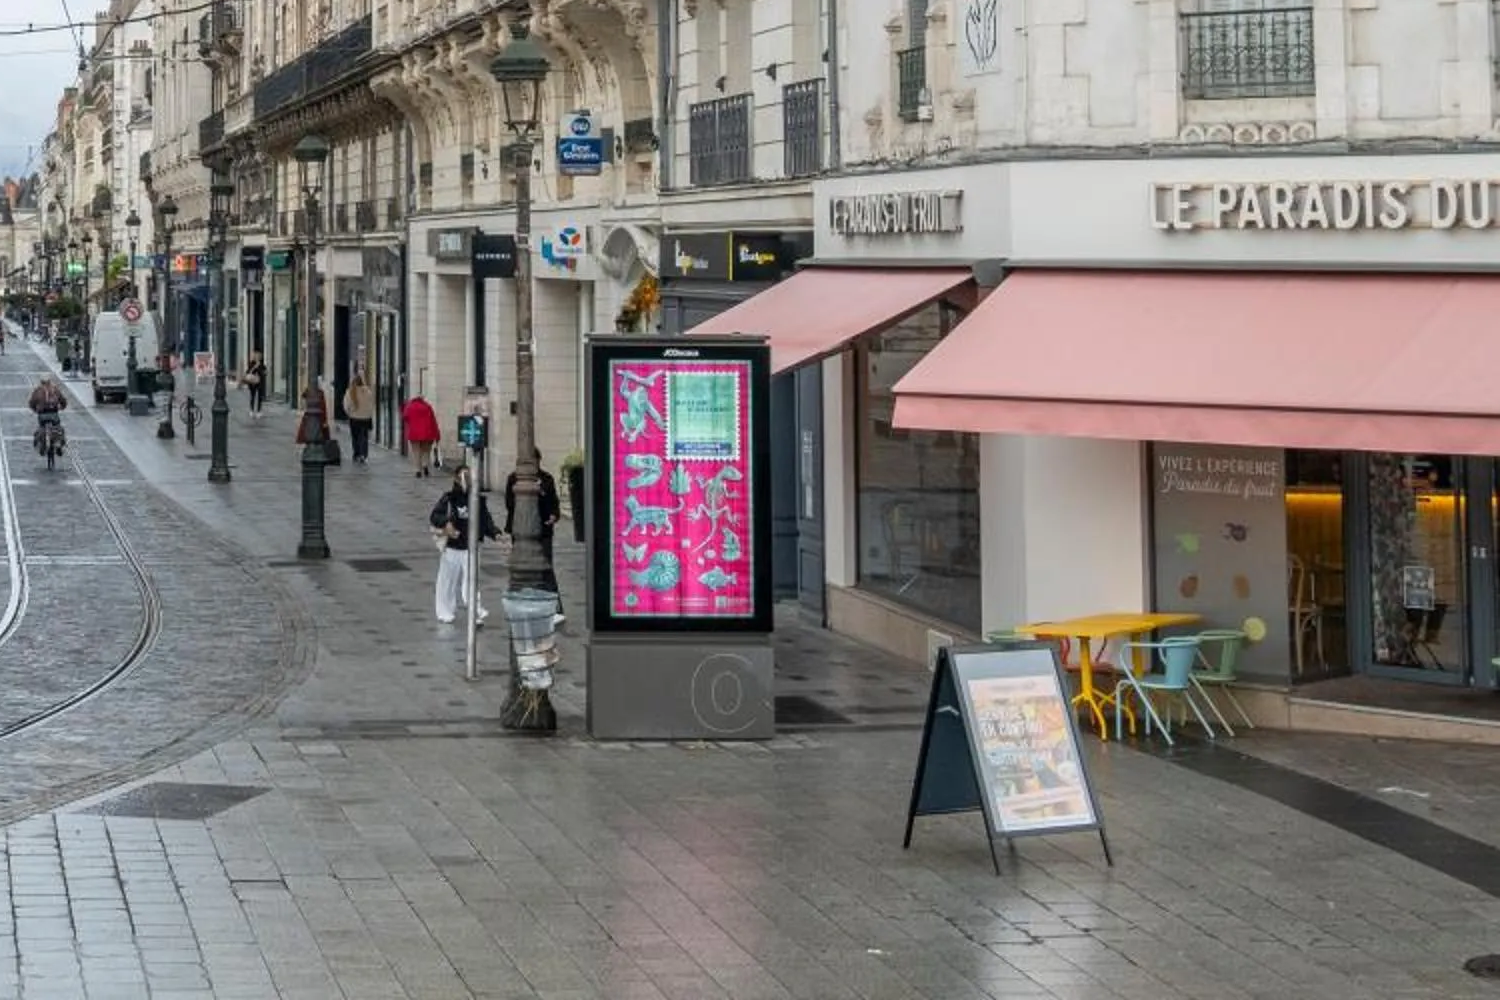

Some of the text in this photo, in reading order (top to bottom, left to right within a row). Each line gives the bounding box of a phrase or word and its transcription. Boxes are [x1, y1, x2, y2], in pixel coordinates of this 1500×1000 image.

[1150, 180, 1489, 230] LE PARADIS DU
[1160, 456, 1192, 471] VIVEZ
